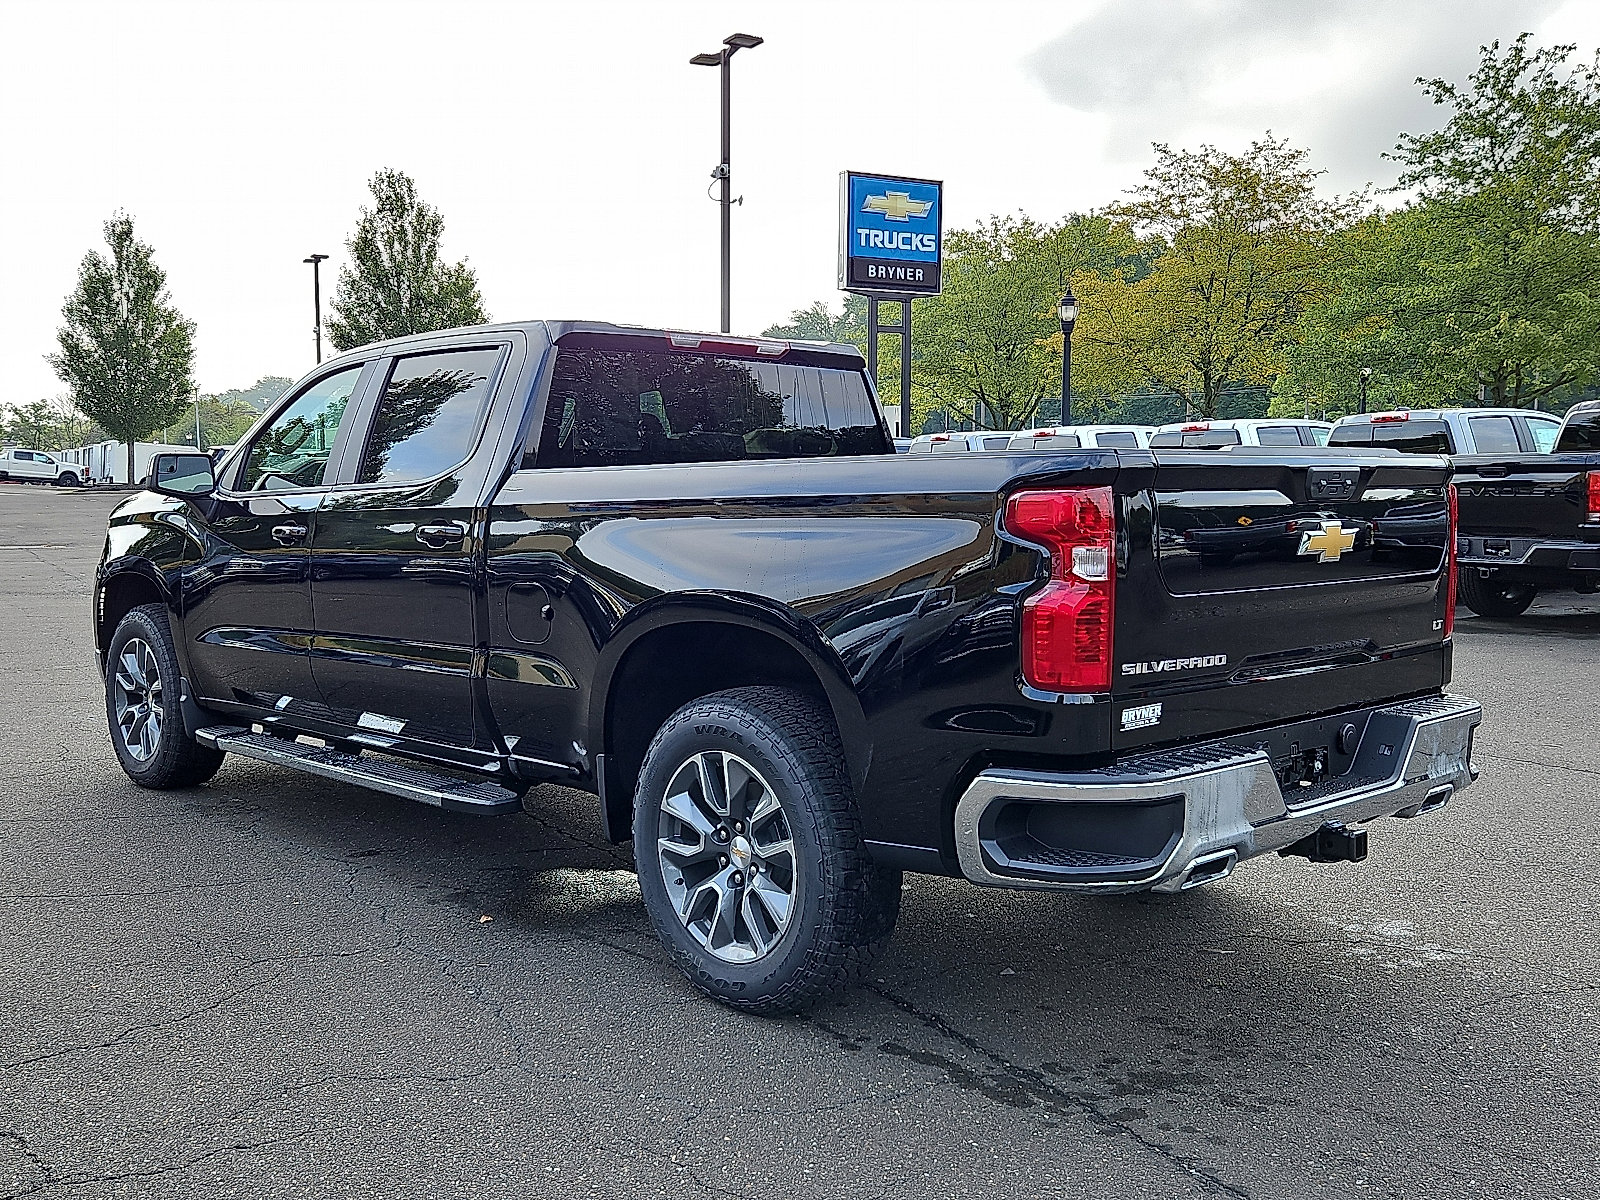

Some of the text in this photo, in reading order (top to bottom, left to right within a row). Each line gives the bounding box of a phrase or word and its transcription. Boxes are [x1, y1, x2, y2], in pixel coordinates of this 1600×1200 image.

[857, 228, 936, 252] TRUCKS
[868, 264, 924, 281] BRYNER
[1458, 486, 1565, 497] EVROLET
[1432, 619, 1444, 631] LT
[1121, 654, 1227, 676] SILVERADO
[1121, 705, 1162, 723] BRYNER
